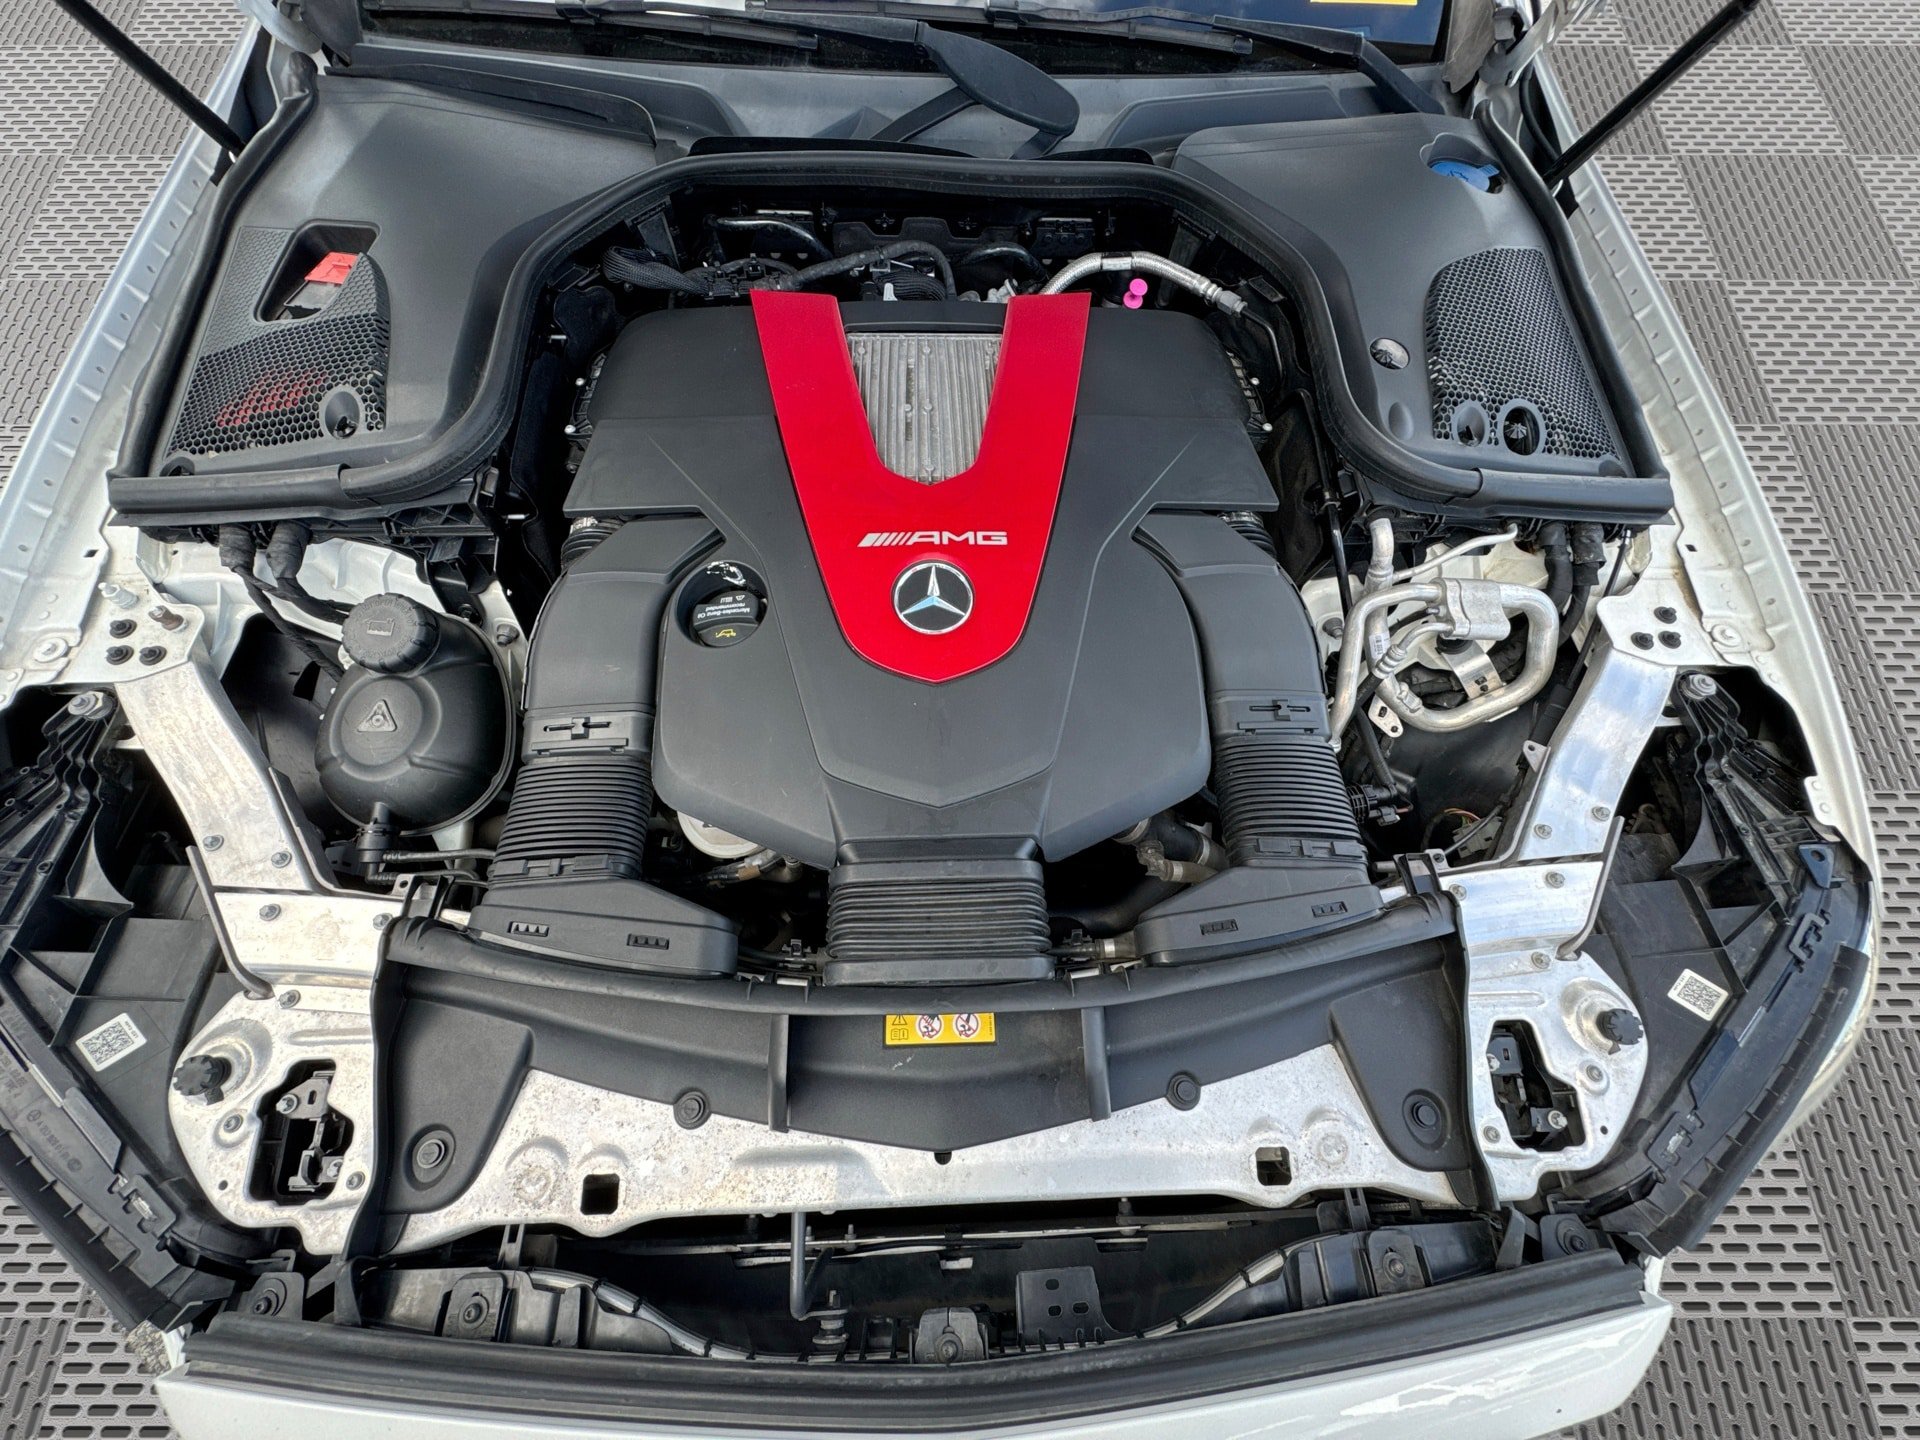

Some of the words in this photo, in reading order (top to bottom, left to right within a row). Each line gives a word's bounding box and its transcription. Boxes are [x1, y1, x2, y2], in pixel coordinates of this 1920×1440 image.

[905, 531, 1008, 545] AMG
[705, 603, 745, 611] recommended
[707, 608, 750, 616] Mercedes-Benz
